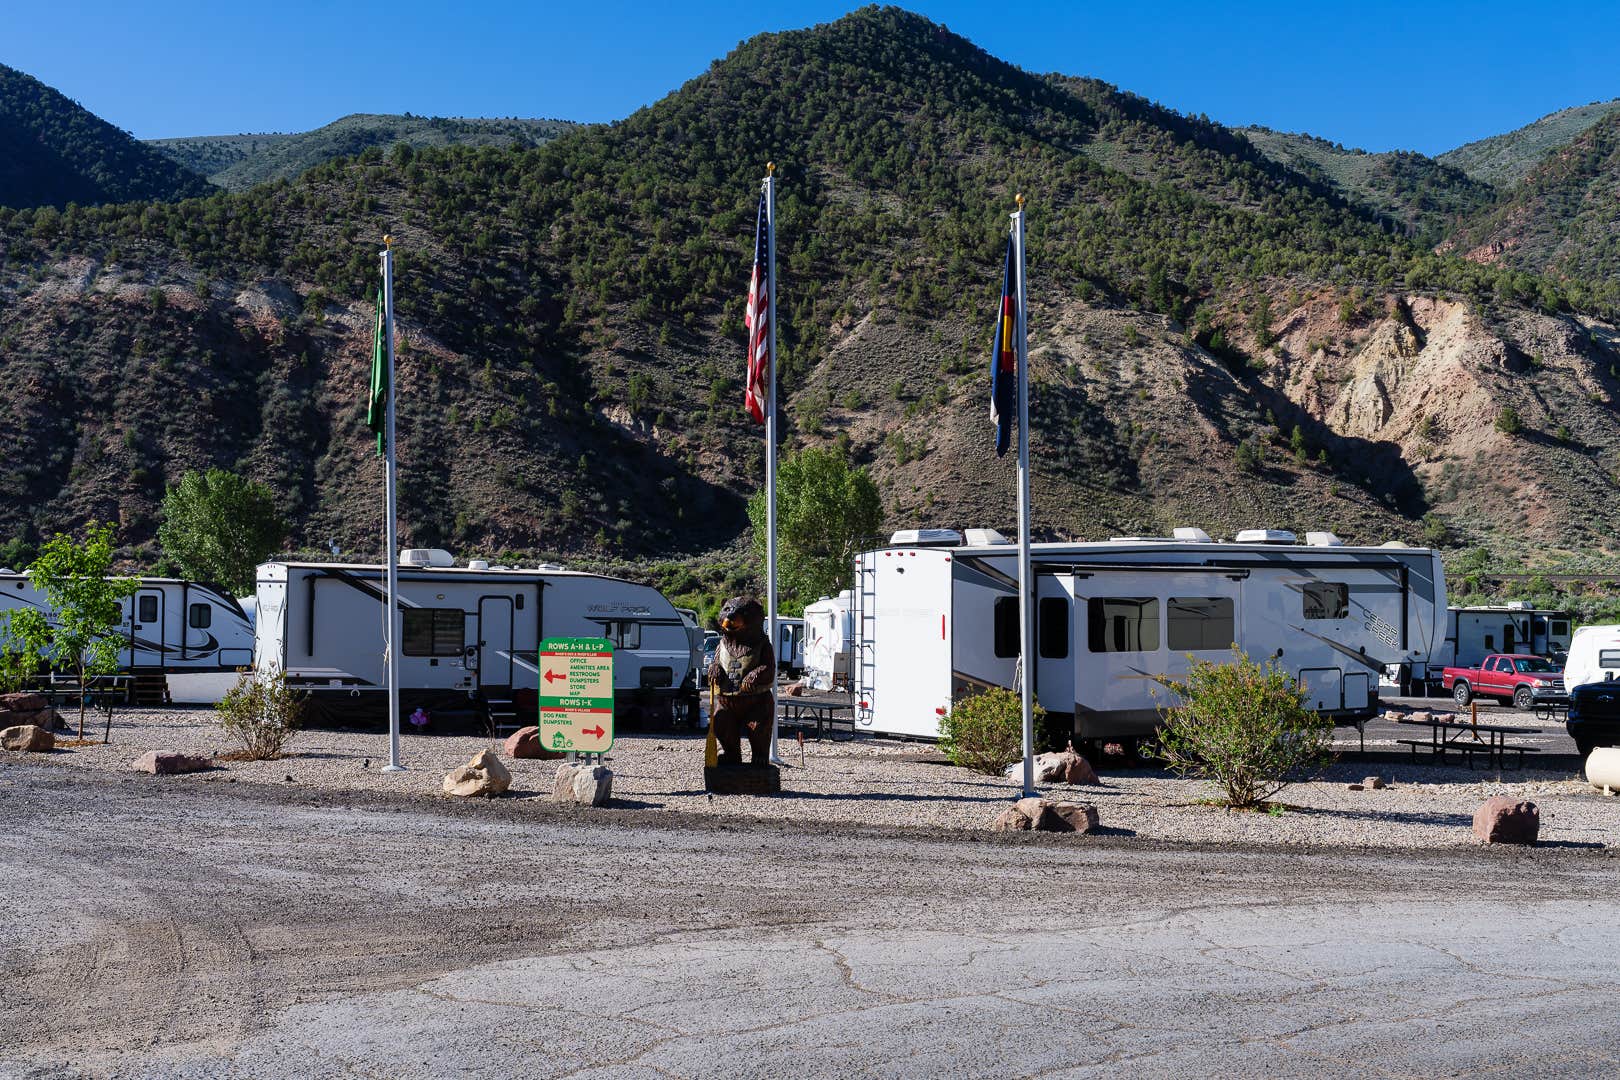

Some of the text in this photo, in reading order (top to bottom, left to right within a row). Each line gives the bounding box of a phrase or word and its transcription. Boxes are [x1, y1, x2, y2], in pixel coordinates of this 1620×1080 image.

[1363, 609, 1398, 638] CEDAR
[1364, 621, 1400, 648] CREEK
[548, 642, 569, 650] ROWS
[585, 643, 591, 651] &
[592, 643, 605, 651] L-P
[559, 698, 581, 706] ROWS
